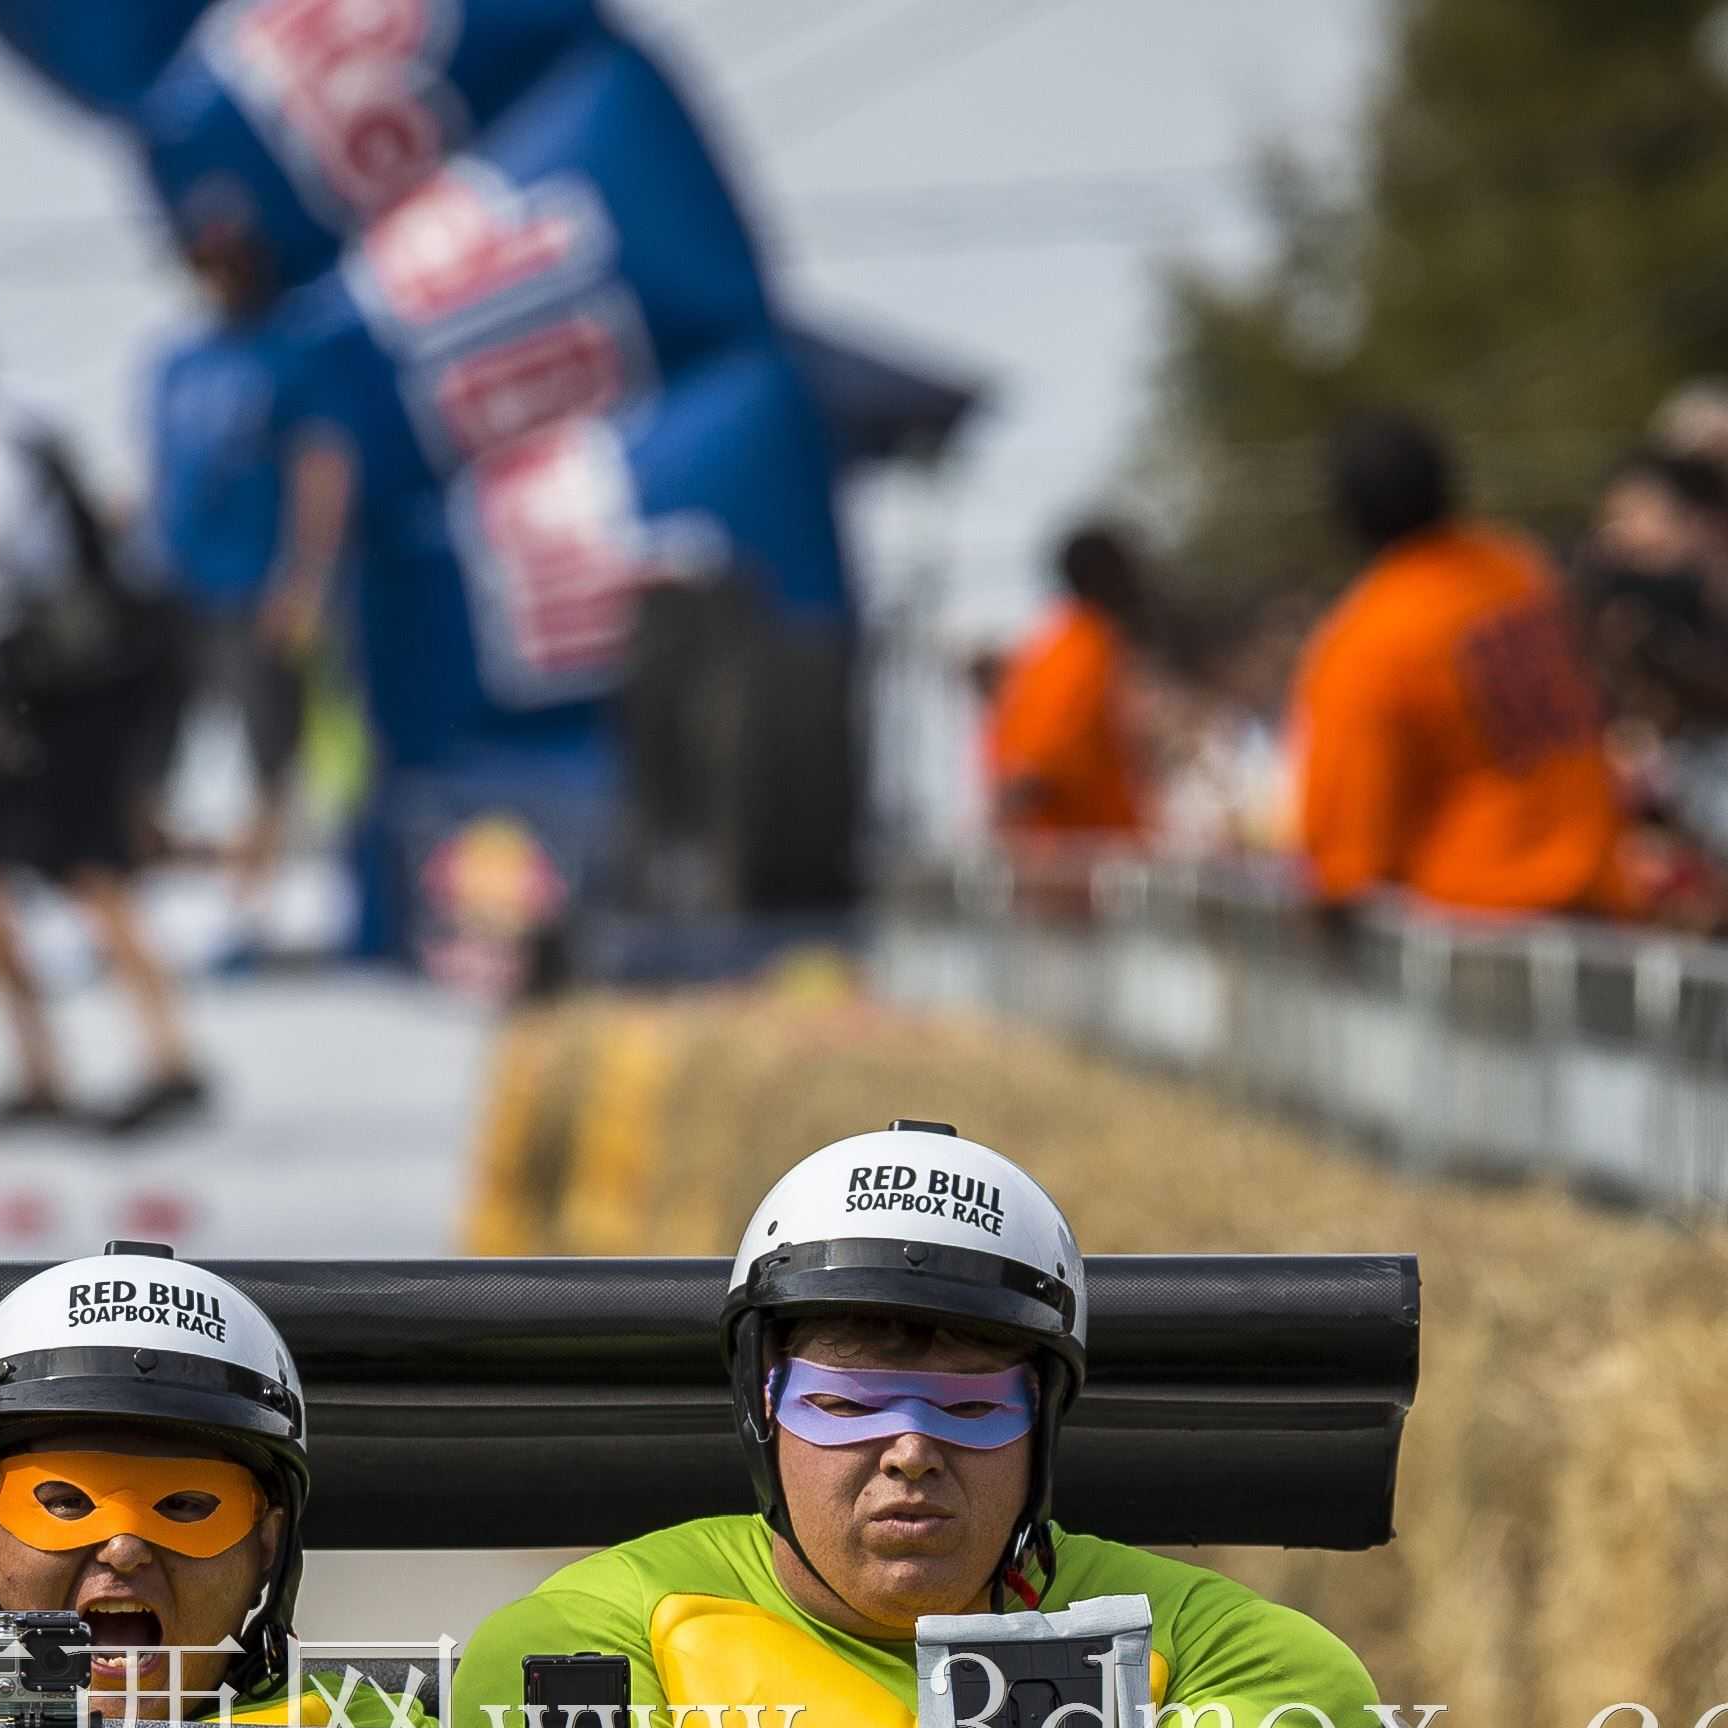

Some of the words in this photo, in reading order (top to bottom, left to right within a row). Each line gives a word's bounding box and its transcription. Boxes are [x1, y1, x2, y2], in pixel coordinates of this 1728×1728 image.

[848, 1165, 917, 1192] RED
[927, 1168, 1005, 1217] BULL
[845, 1192, 947, 1217] SOAPBOX
[952, 1202, 1004, 1237] RACE
[68, 1280, 137, 1309] RED
[148, 1281, 226, 1325] BULL
[68, 1305, 170, 1328] SOAPBOX
[176, 1309, 226, 1344] RACE
